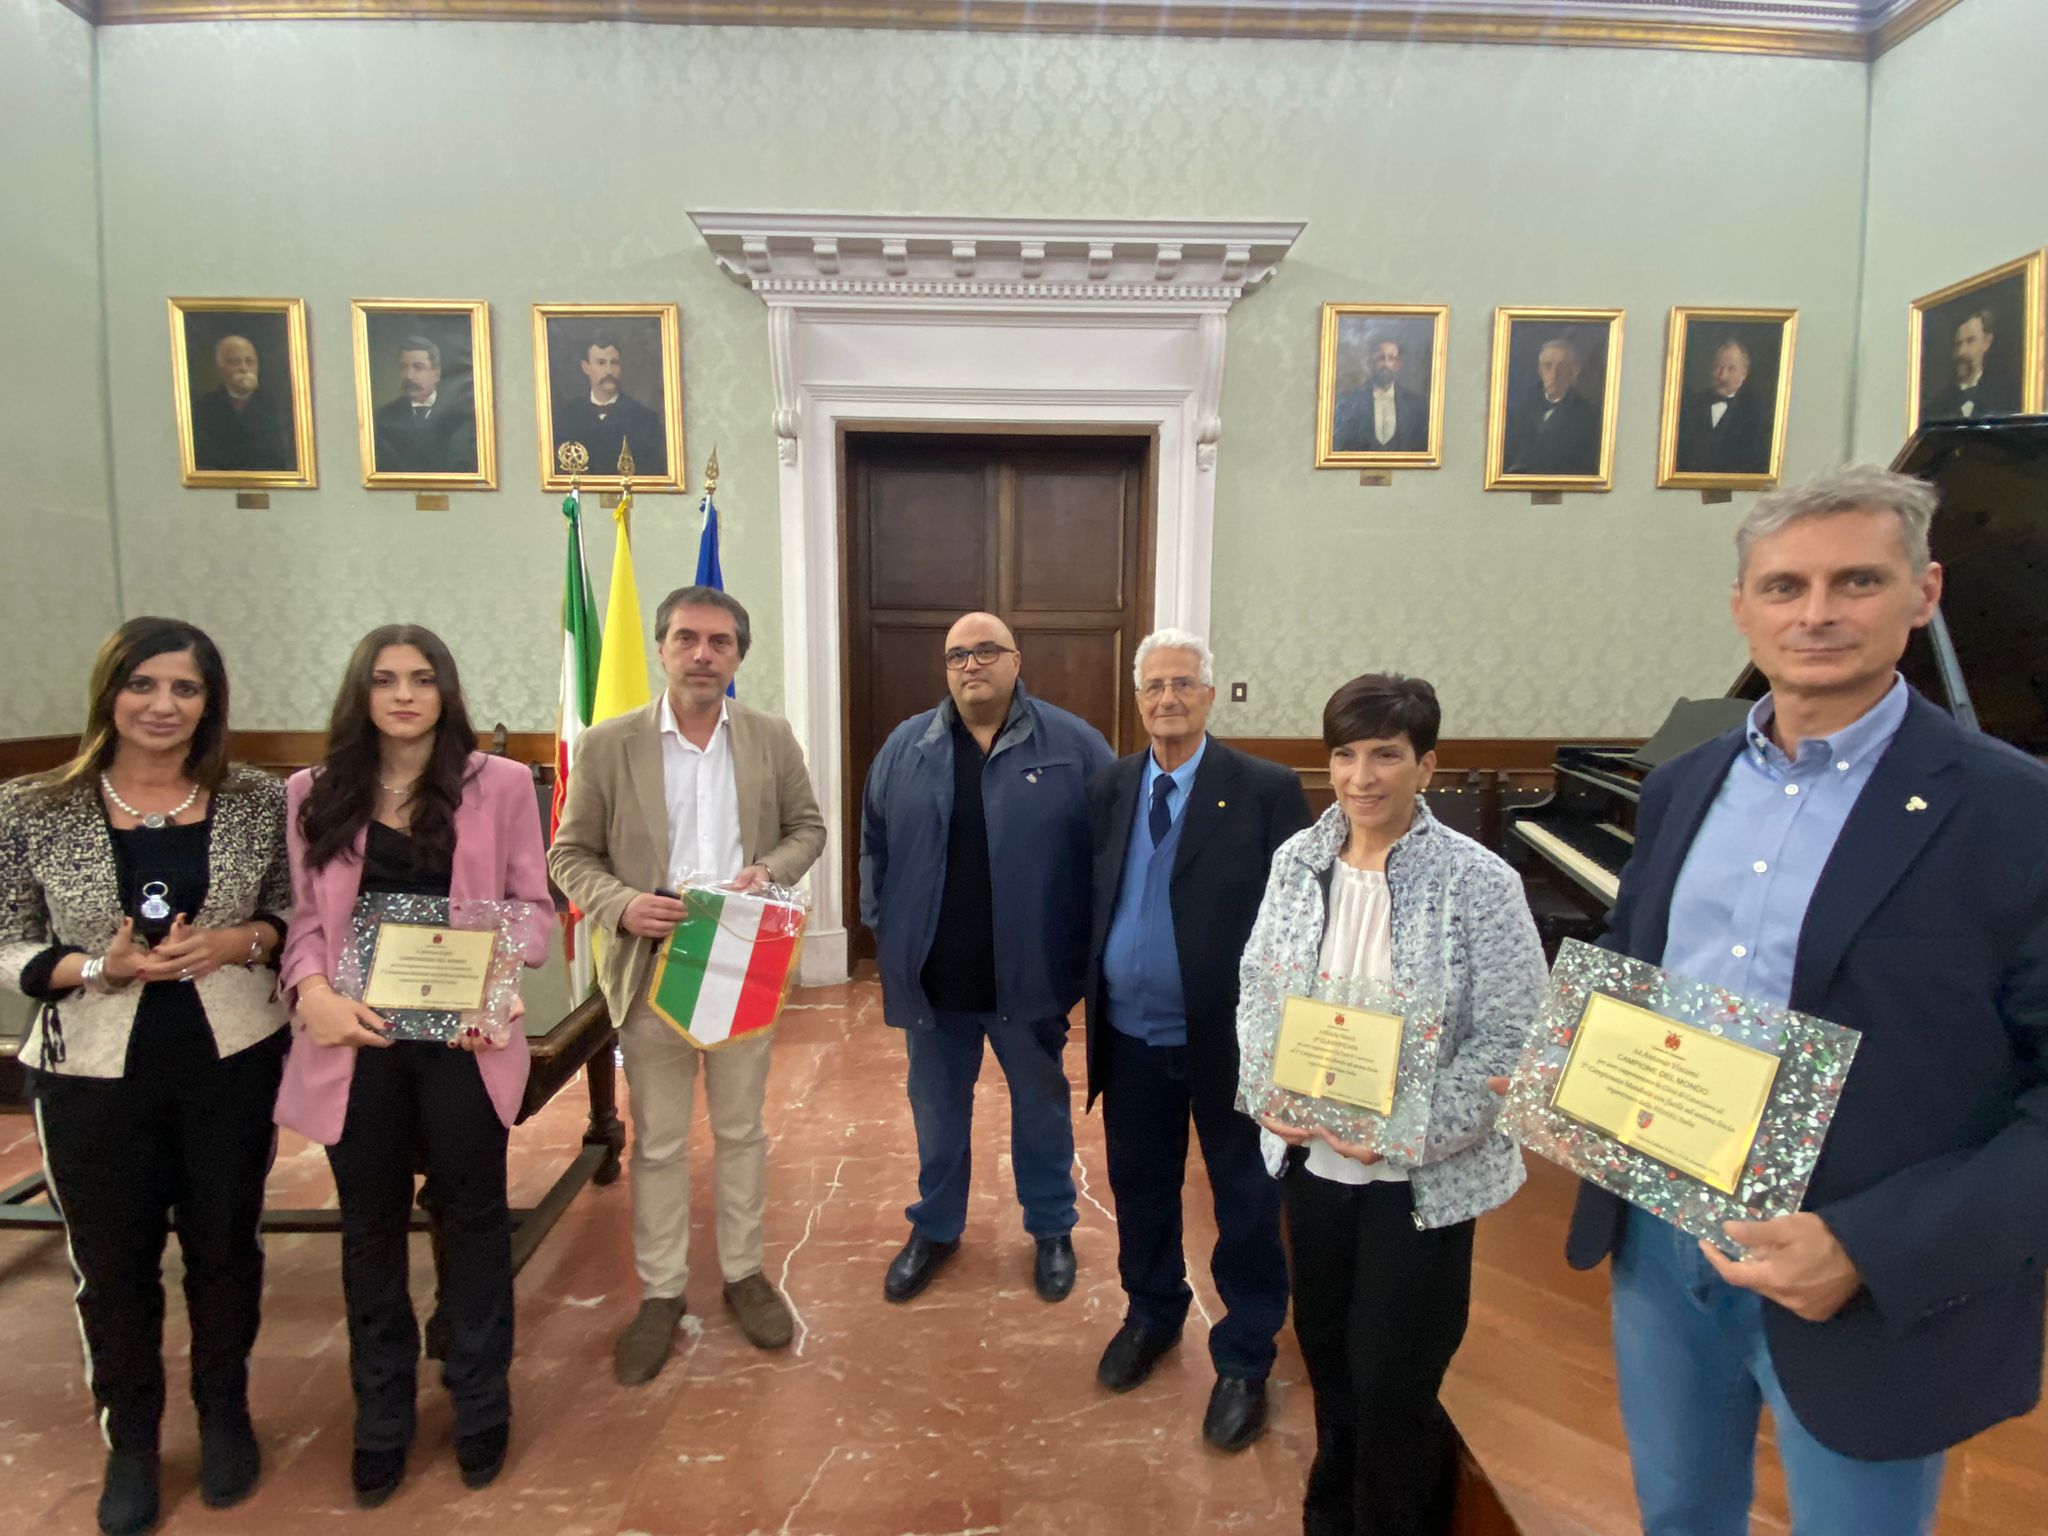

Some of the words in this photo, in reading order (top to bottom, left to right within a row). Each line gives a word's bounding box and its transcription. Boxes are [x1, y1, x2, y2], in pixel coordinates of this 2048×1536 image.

[1616, 1052, 1658, 1075] CAMPIONE
[1658, 1069, 1675, 1082] DEL
[1675, 1076, 1709, 1096] MONDO
